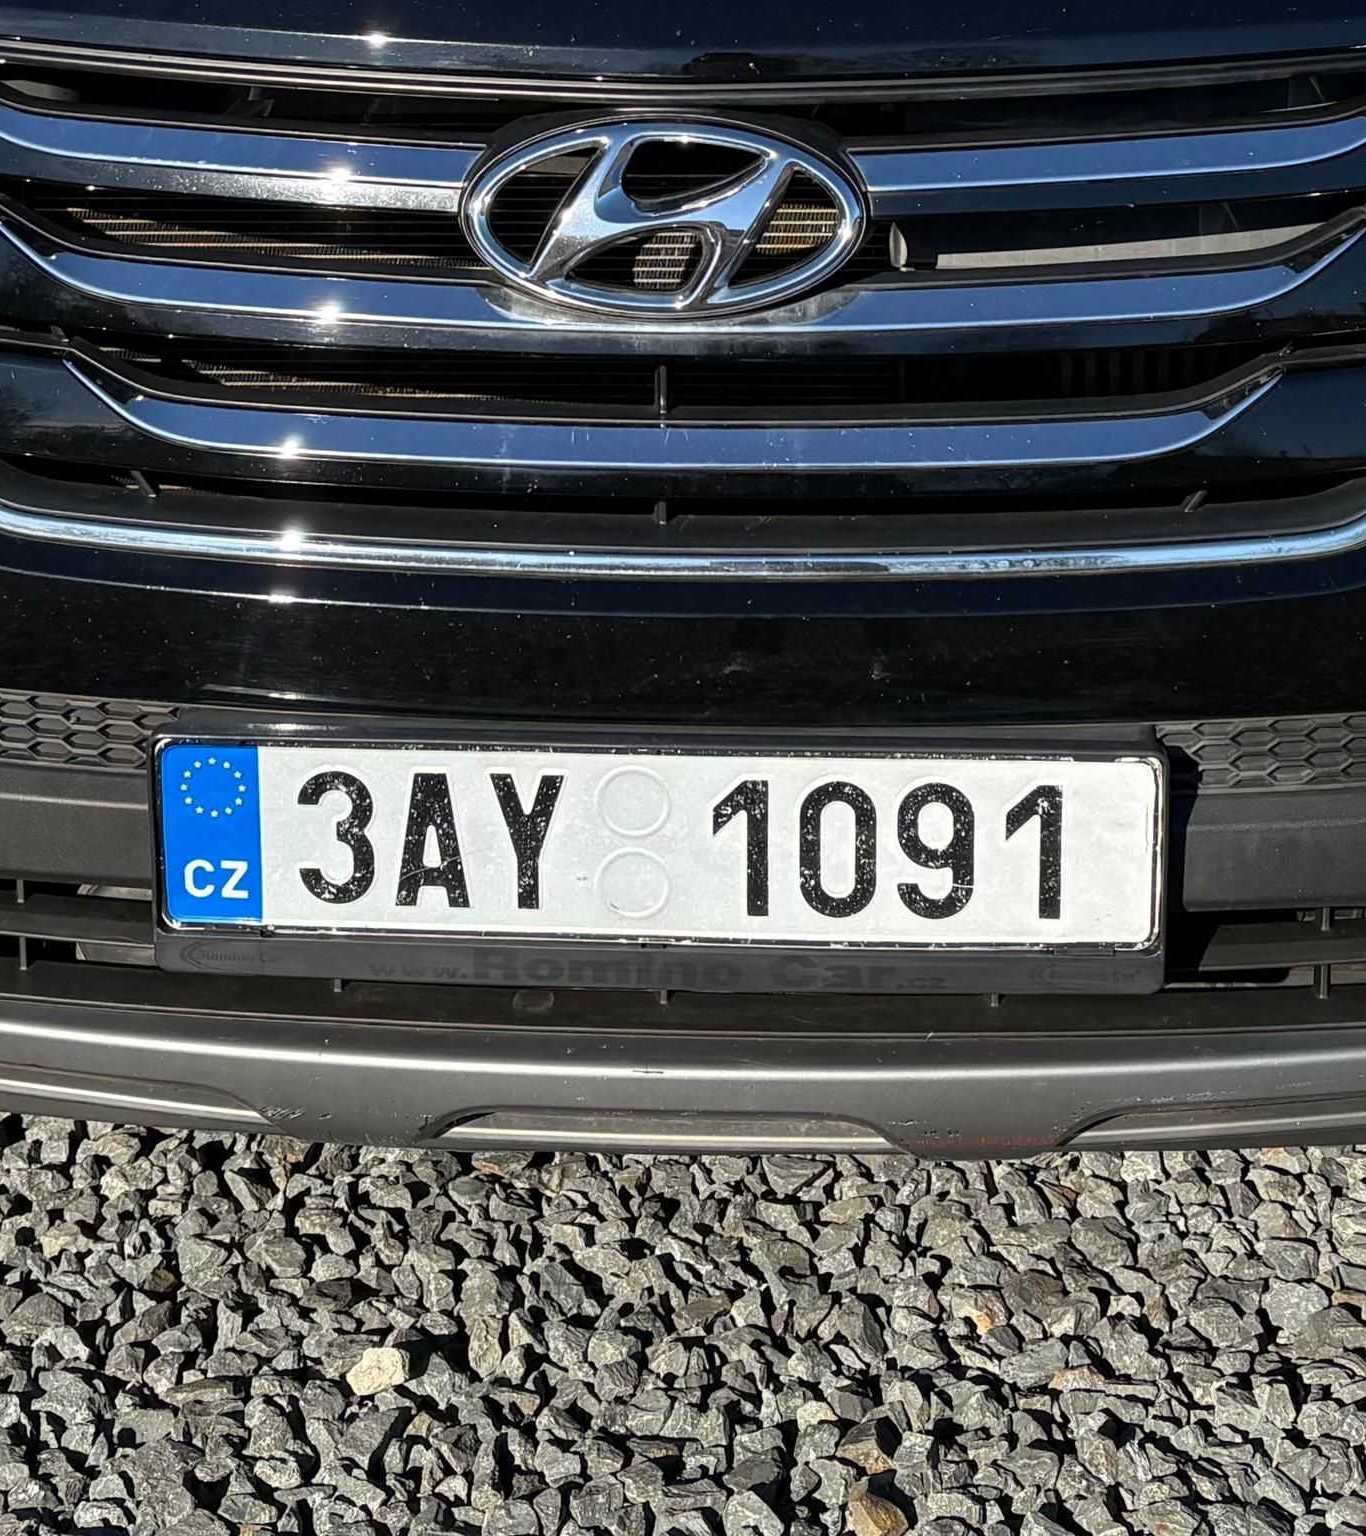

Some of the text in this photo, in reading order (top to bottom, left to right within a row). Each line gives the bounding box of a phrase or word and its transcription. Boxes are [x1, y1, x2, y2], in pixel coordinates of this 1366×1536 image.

[184, 859, 250, 899] CZ
[297, 771, 1064, 921] 3AY 1091
